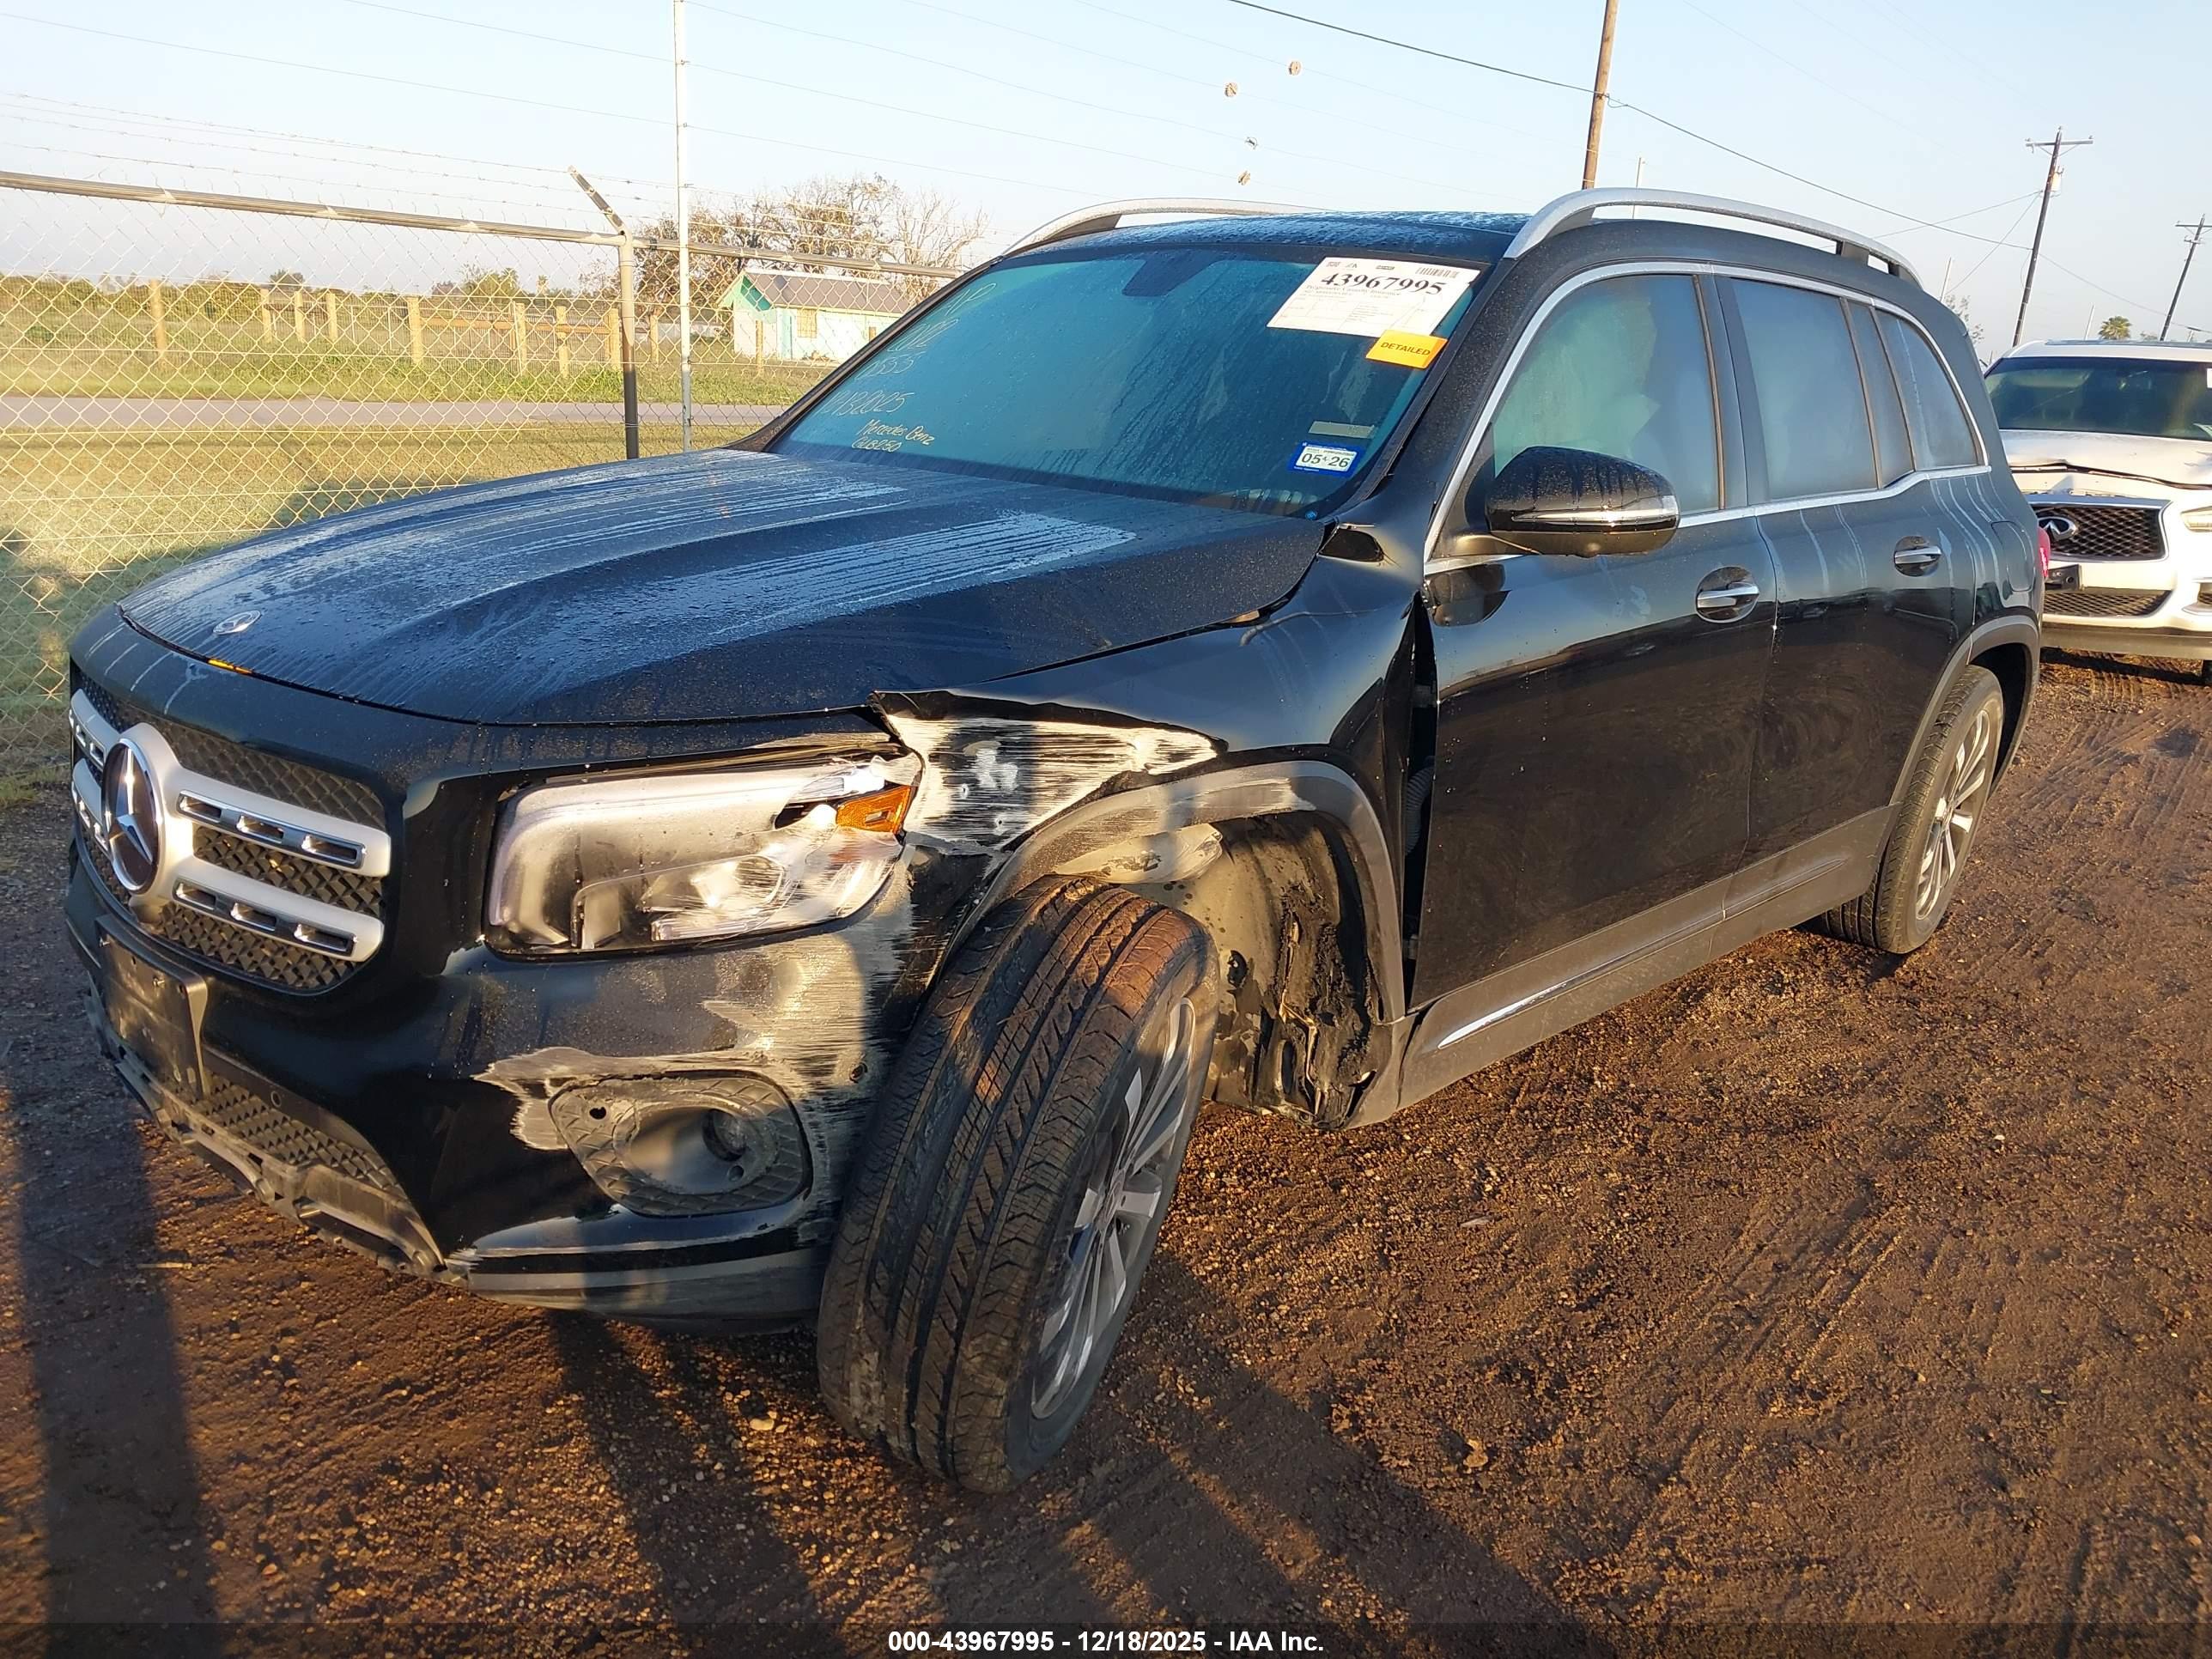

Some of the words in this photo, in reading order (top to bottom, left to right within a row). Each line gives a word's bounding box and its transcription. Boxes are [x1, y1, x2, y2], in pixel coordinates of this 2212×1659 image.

[1321, 272, 1447, 295] 43967995
[1380, 341, 1431, 356] DETAILED
[905, 425, 935, 446] Benz
[1301, 453, 1323, 465] 05
[1328, 456, 1351, 468] 26
